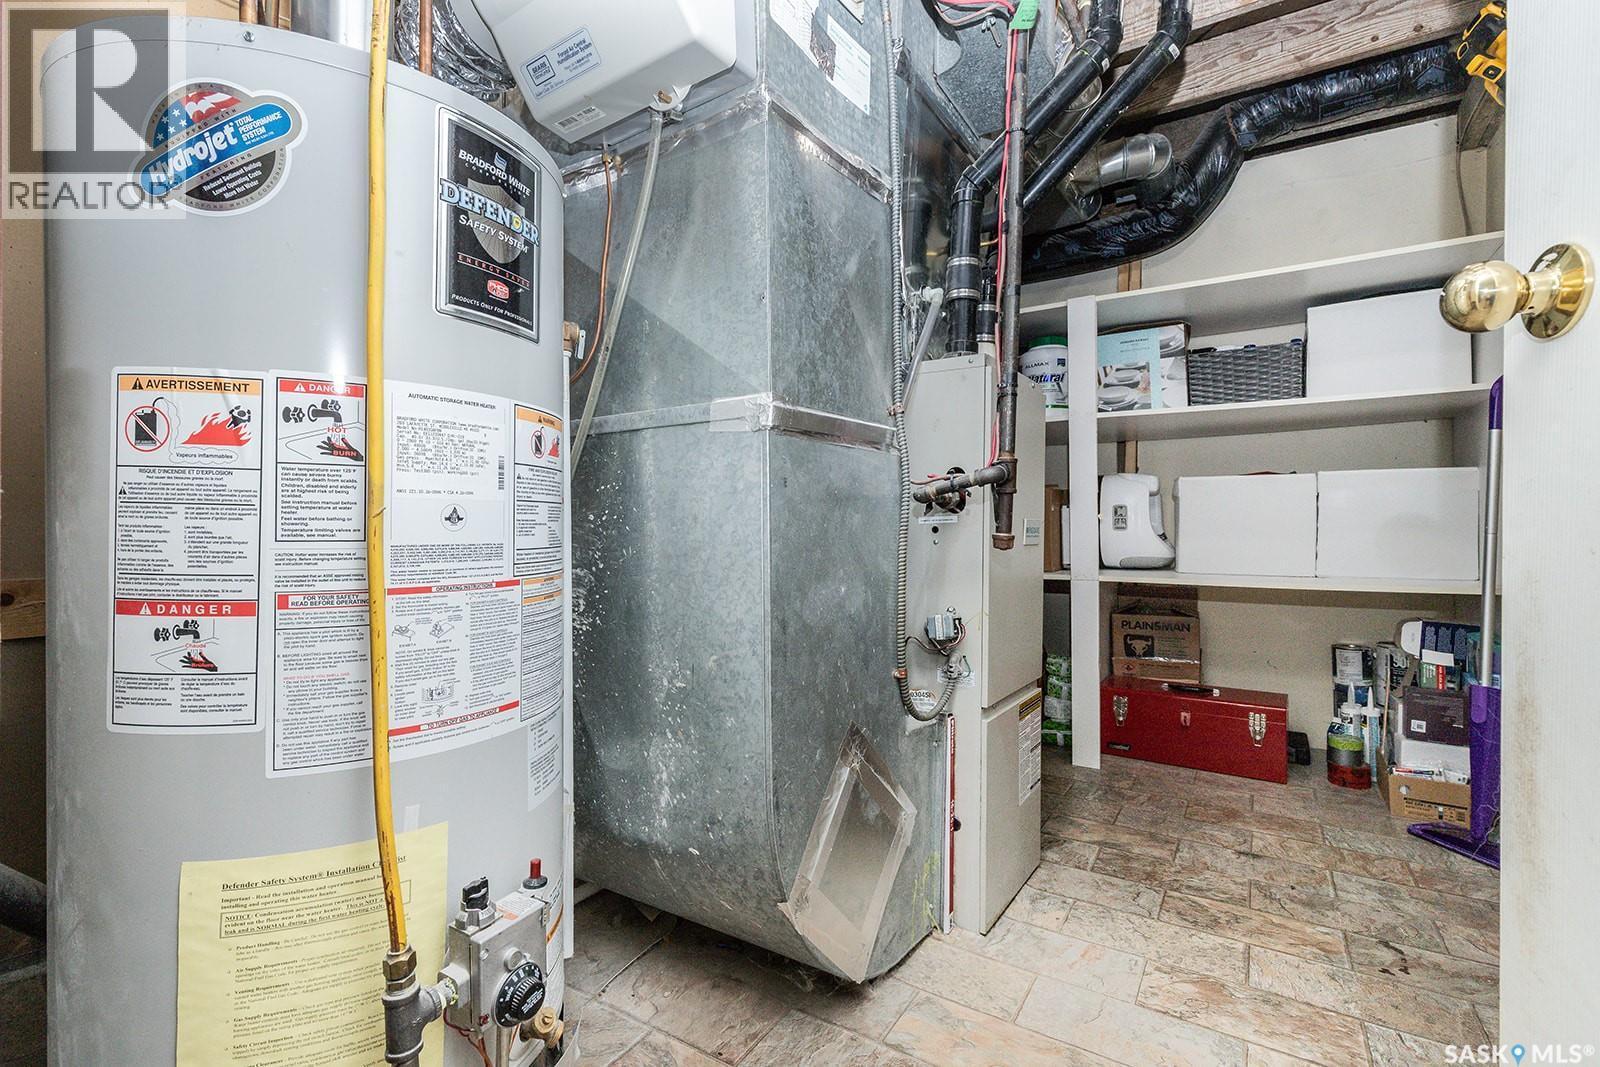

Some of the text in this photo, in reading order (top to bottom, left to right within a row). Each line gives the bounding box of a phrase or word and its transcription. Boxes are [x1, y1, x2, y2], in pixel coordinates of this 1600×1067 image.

[214, 108, 237, 124] WITH
[235, 114, 254, 127] TOTAL
[238, 111, 283, 134] PERFORMANCE
[242, 126, 267, 142] SYSTEM
[148, 124, 238, 184] Hydrojet
[200, 153, 254, 180] FEATURING
[458, 149, 508, 180] BRADFORD
[508, 174, 532, 196] WHITE
[440, 178, 539, 247] DEFENDER
[458, 214, 528, 254] SAFETY SYSTEM
[451, 294, 479, 306] PRODUCTS
[480, 302, 493, 311] ONLY
[494, 306, 503, 314] FOR
[146, 380, 250, 392] AVERTISSEMENT
[408, 393, 438, 402] AUTOMATIC
[439, 397, 462, 405] STORAGE
[328, 426, 346, 434] HOT
[195, 469, 232, 477] D'EXPLOSION
[157, 604, 232, 614] DANGER
[1120, 619, 1191, 633] PLAINSMAN
[288, 873, 323, 881] System®
[326, 865, 371, 876] Installation
